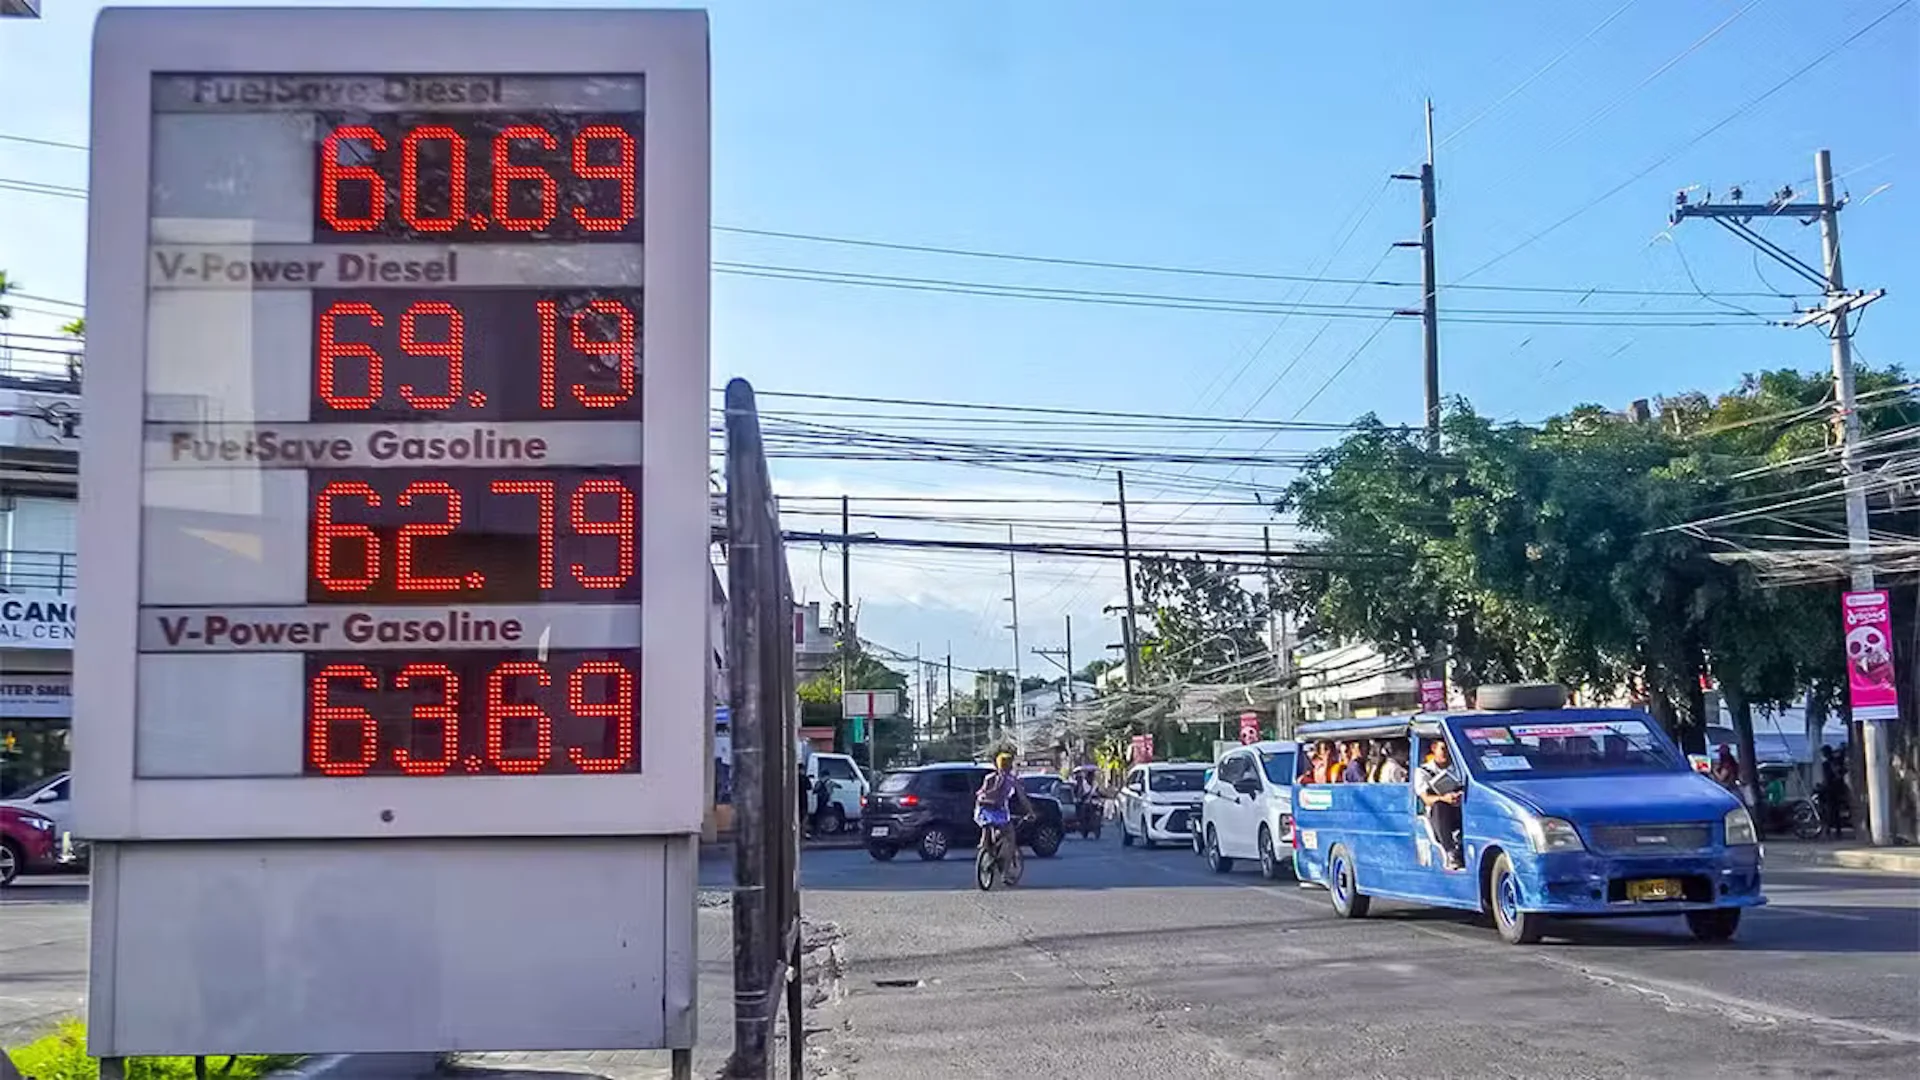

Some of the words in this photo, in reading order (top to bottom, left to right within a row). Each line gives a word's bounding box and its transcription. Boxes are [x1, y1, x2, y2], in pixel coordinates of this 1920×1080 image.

[194, 78, 369, 103] FuelSave
[383, 76, 502, 102] Diesel
[320, 125, 637, 232] 60.69
[156, 251, 324, 283] V-Power
[337, 251, 458, 283] Diesel
[319, 300, 635, 410] 69.19
[170, 431, 353, 461] FuelSave
[368, 429, 548, 461] Gasoline
[314, 479, 635, 591] 62.79
[158, 615, 329, 645] V-Power
[343, 611, 523, 643] Gasoline
[311, 661, 633, 776] 63.69
